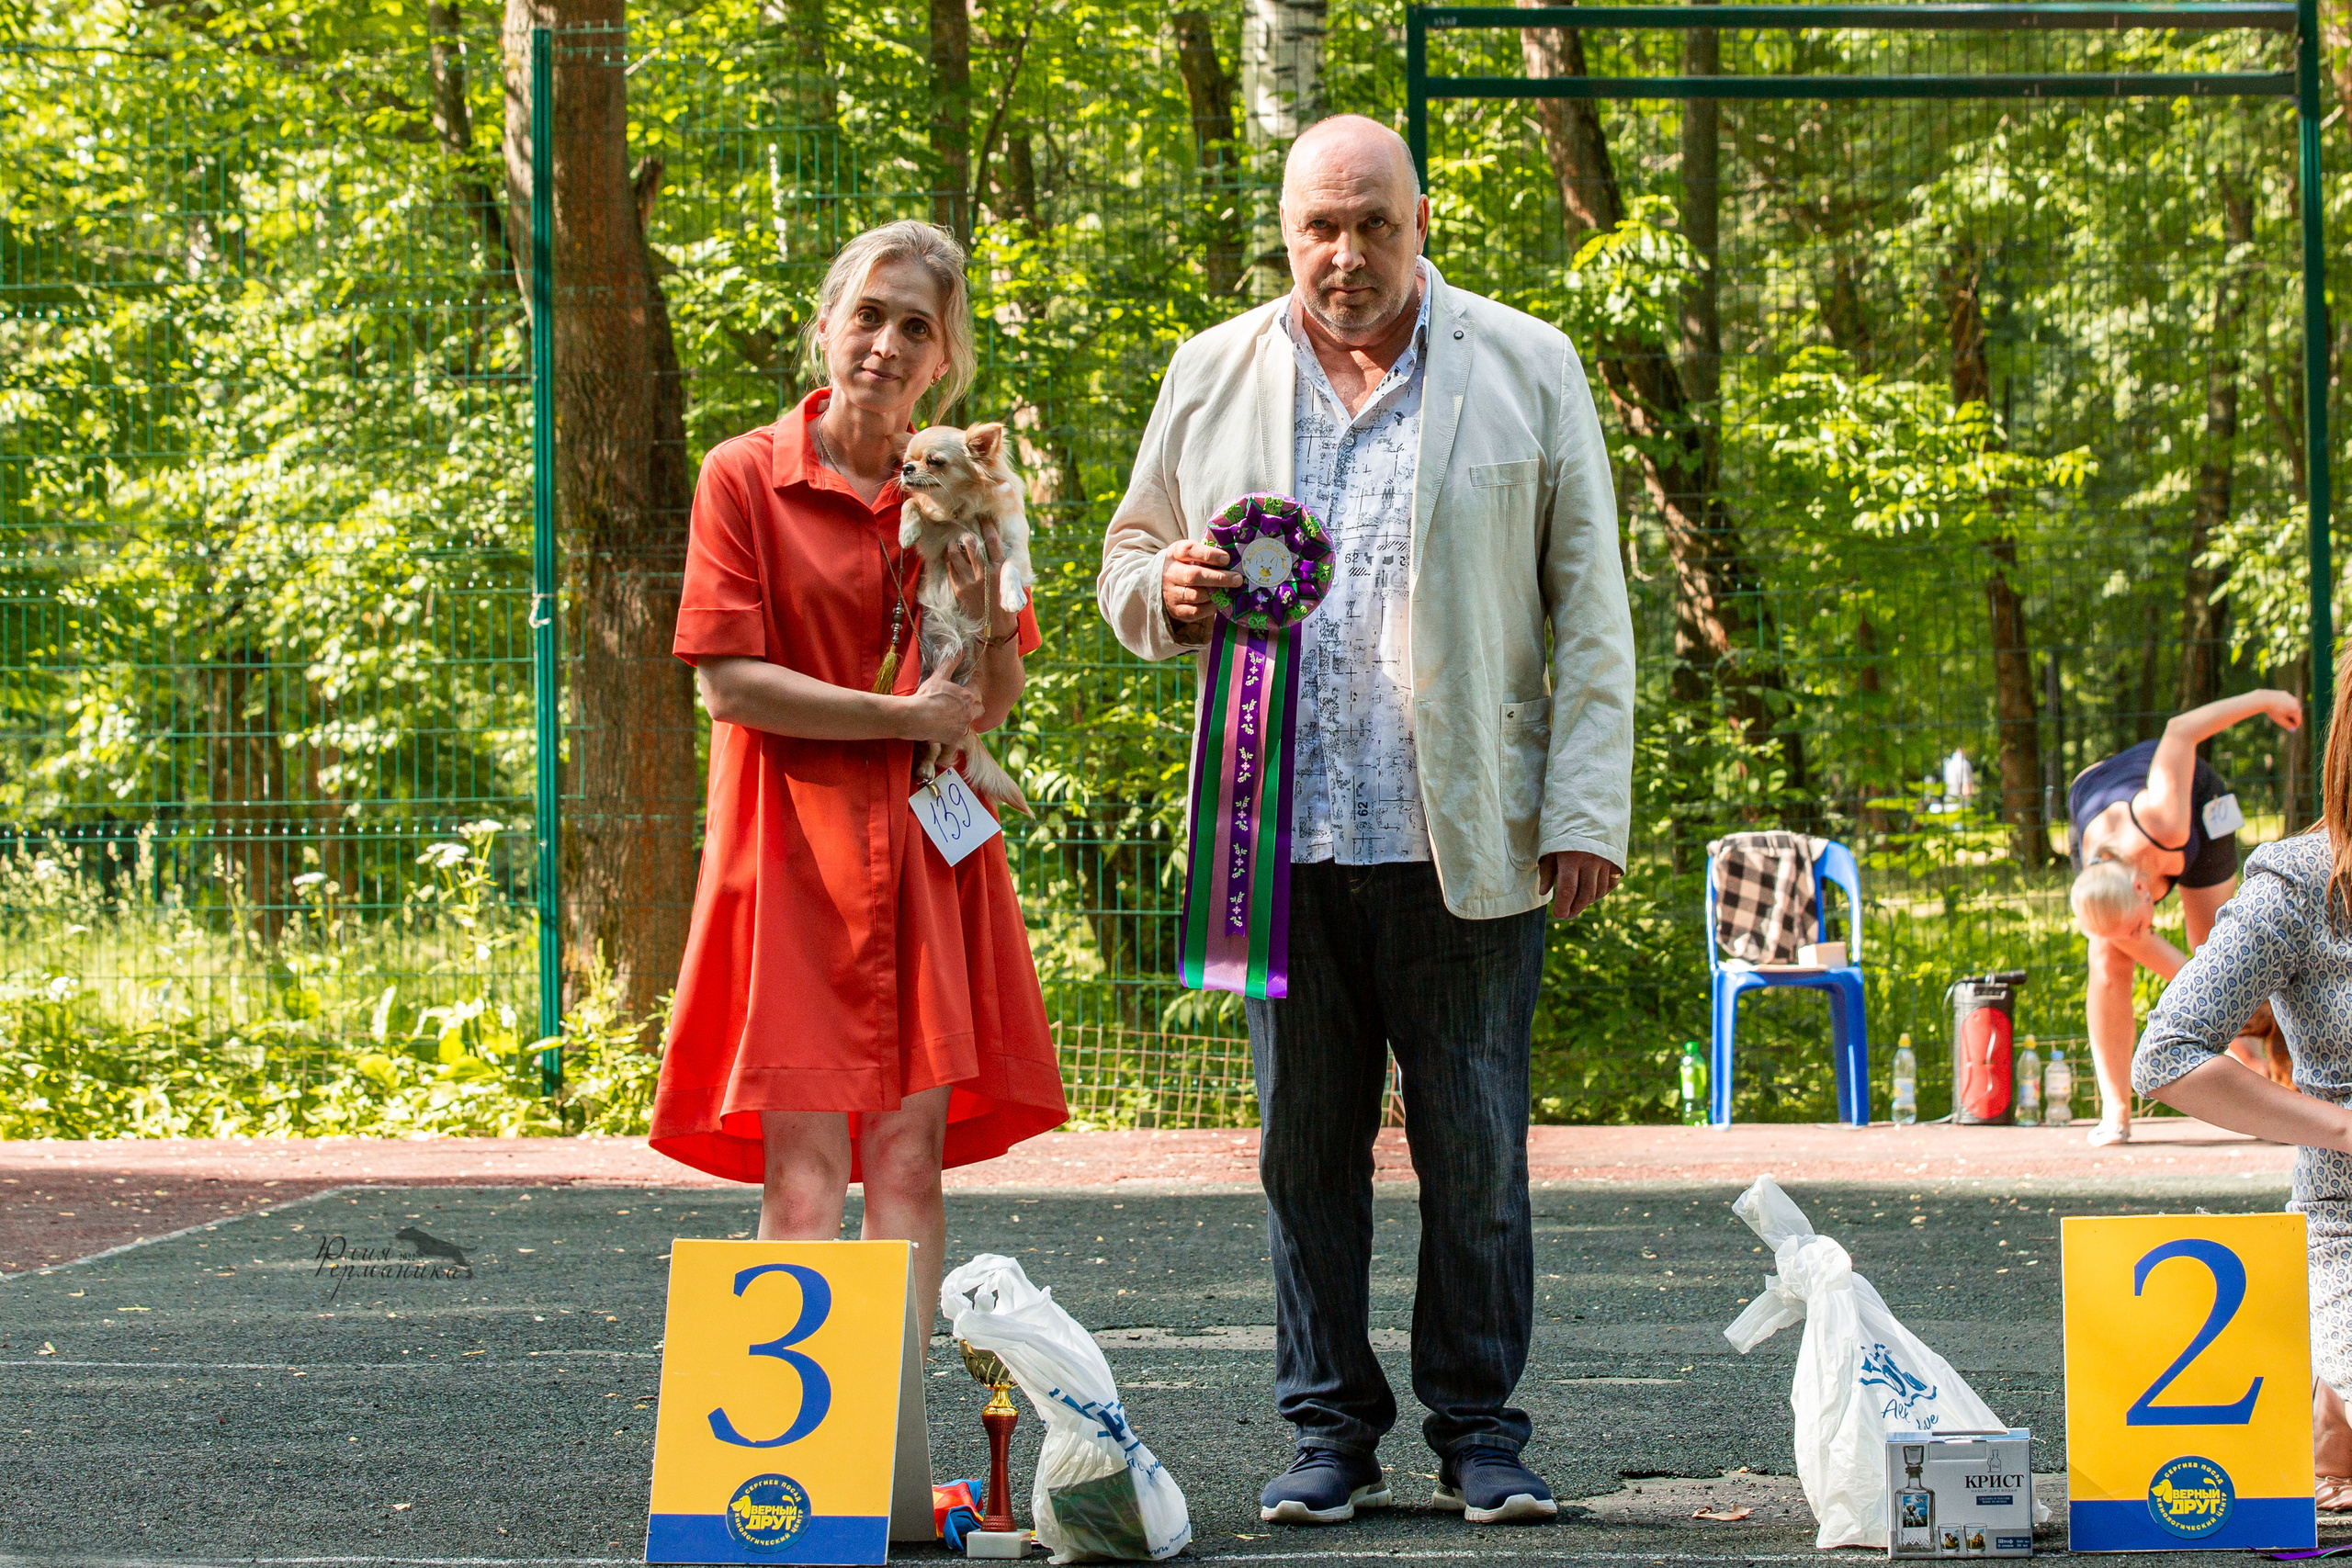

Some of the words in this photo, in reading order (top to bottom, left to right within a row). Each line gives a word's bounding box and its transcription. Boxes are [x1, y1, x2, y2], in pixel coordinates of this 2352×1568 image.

[930, 783, 971, 843] 139
[1357, 802, 1368, 817] 62
[2126, 1238, 2264, 1427] 2
[707, 1263, 831, 1449] 3
[1964, 1474, 2025, 1488] КРИСТ
[2164, 1462, 2198, 1478] СЕРГИЕВ
[2200, 1464, 2223, 1484] ПОСАД
[745, 1479, 779, 1495] СЕРГИЕВ
[781, 1481, 802, 1503] ПОСАД
[2172, 1488, 2221, 1499] ВЕРНЫЙ
[751, 1505, 797, 1516] ВЕРНЫЙ
[2155, 1497, 2217, 1531] КИНОЛОГИЧЕСКИЙ
[2215, 1492, 2228, 1517] ЦЕНТР
[2168, 1498, 2221, 1515] ДРУГ
[734, 1512, 791, 1546] КИНОЛОГИЧЕСКИЙ
[790, 1509, 804, 1534] ЦЕНТР
[745, 1515, 797, 1531] ДРУГ
